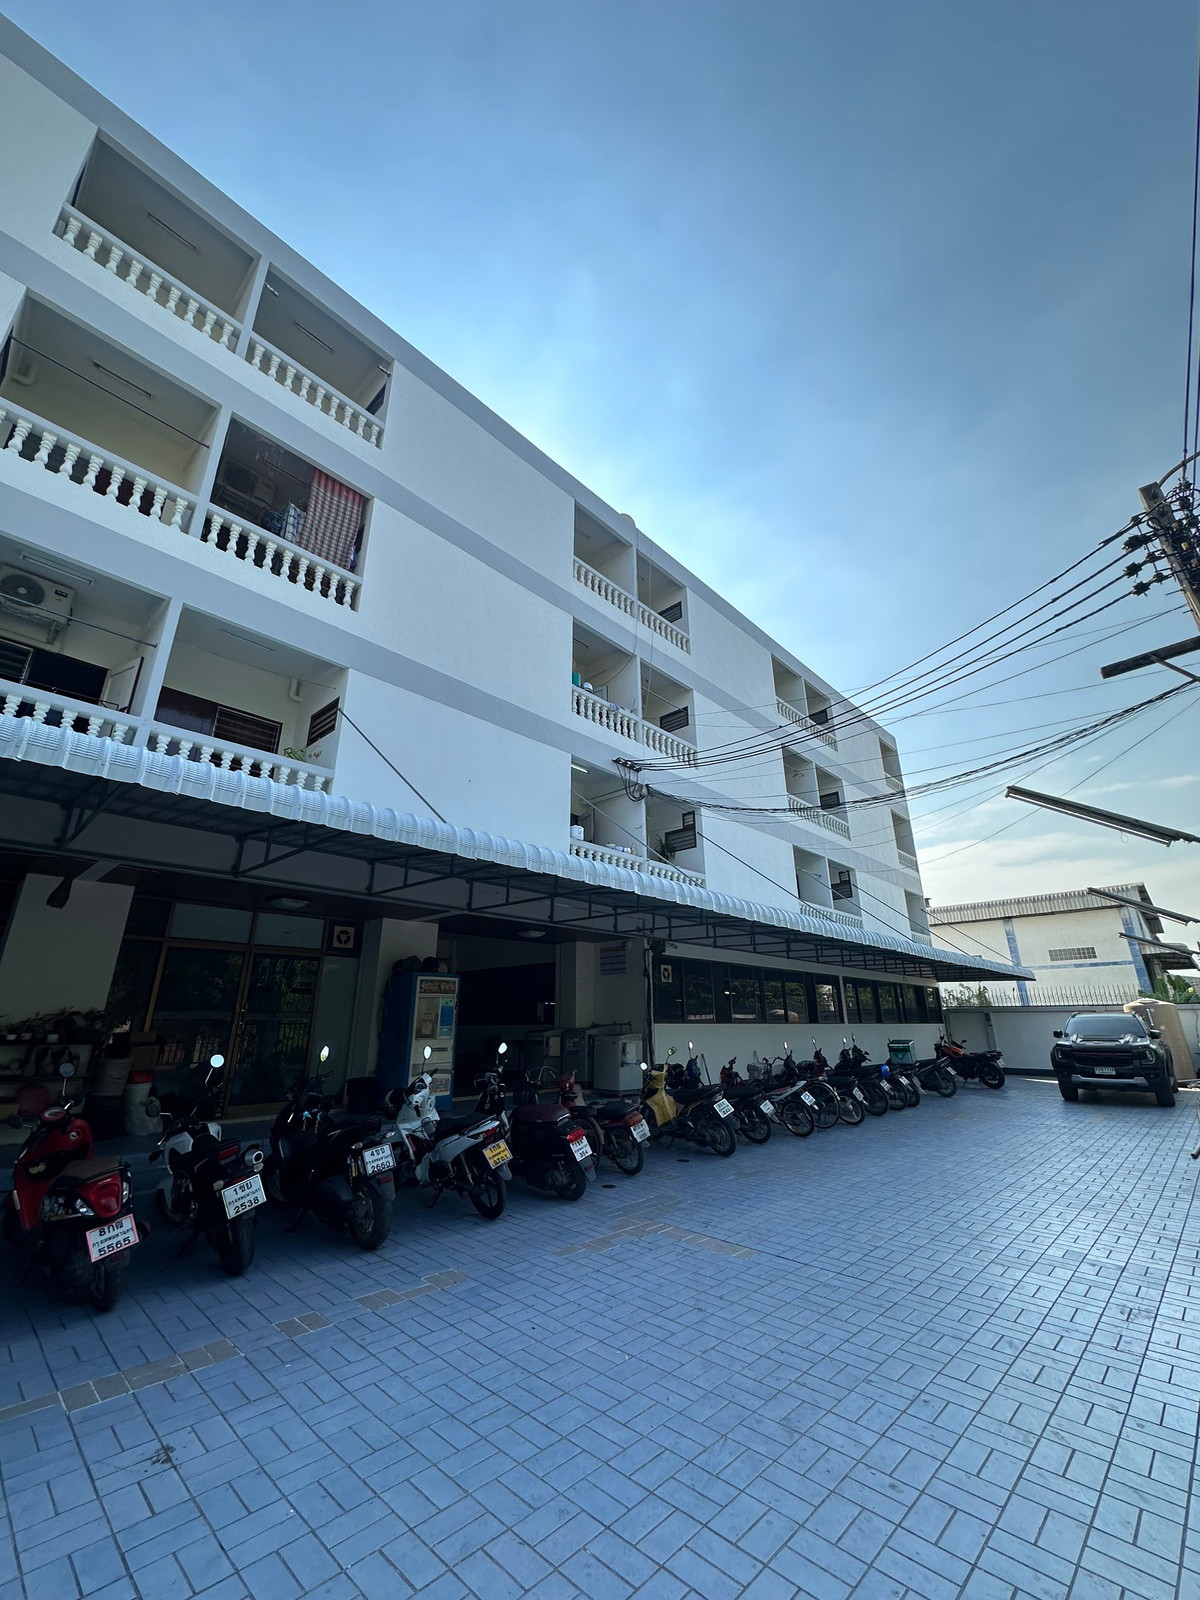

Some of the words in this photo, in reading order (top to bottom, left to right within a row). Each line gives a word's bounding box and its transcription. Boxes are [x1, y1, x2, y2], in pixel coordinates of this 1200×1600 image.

[370, 1160, 391, 1173] 2660
[233, 1181, 253, 1195] 1ขย
[233, 1196, 260, 1214] 2538
[98, 1236, 131, 1256] 5565
